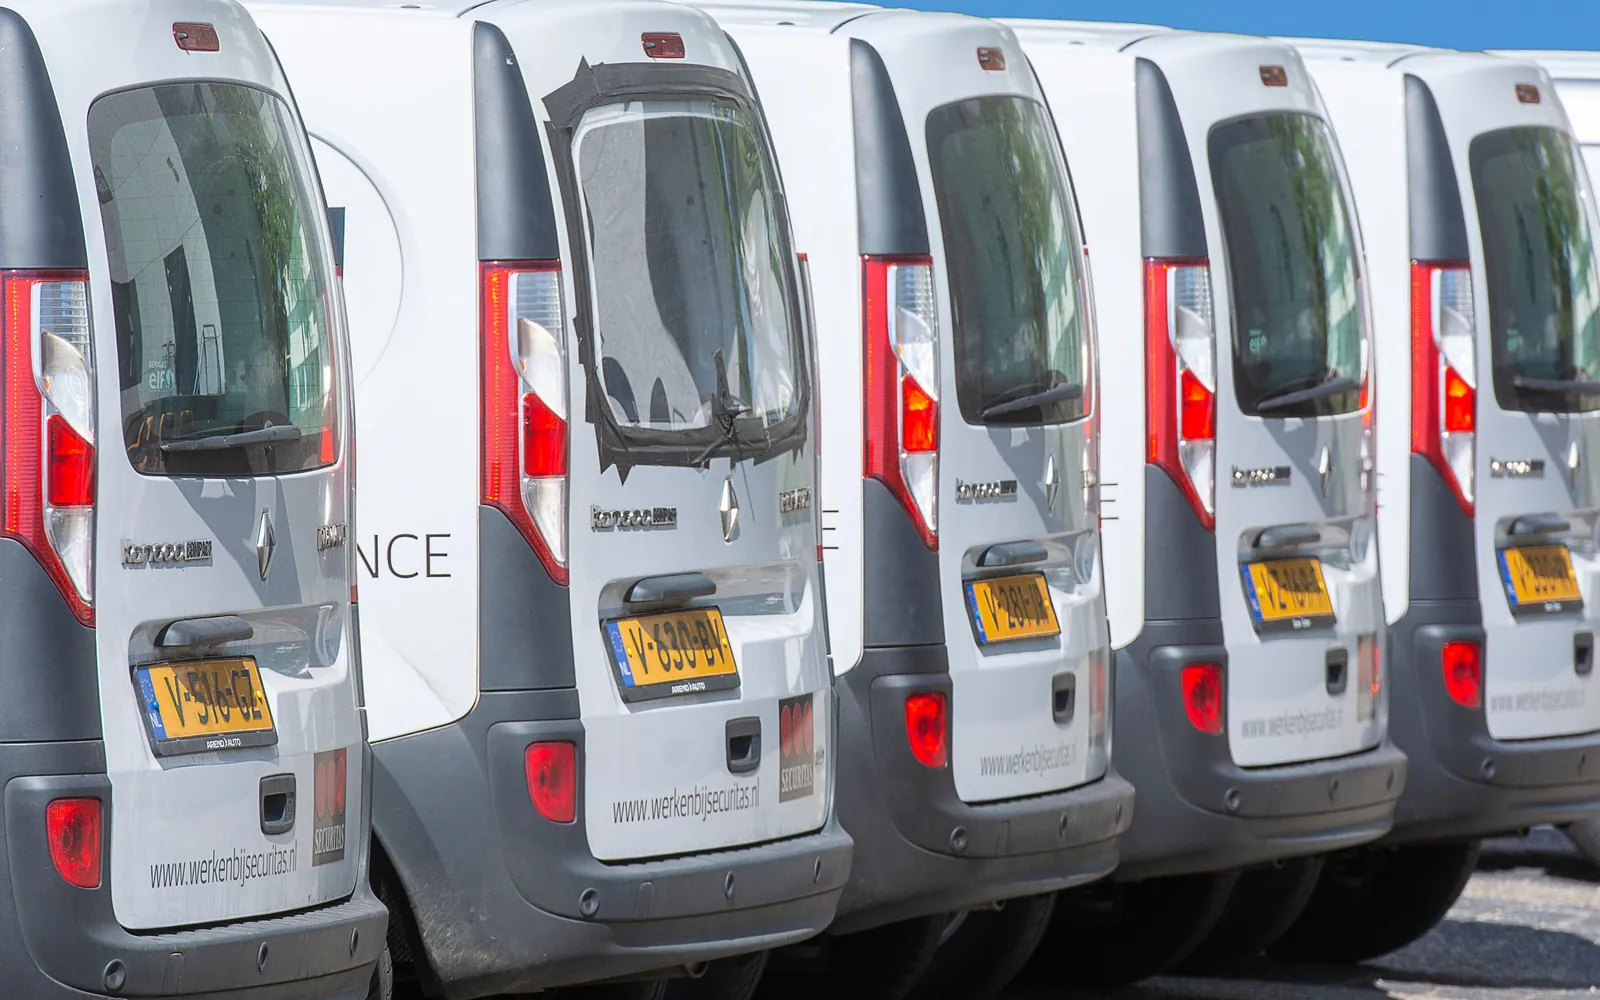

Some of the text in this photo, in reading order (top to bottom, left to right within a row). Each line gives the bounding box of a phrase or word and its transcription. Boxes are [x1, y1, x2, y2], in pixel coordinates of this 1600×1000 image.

[149, 370, 166, 389] elf
[120, 538, 185, 563] Kangoo
[356, 533, 452, 579] NCE
[628, 618, 726, 675] V-630-BV
[619, 661, 631, 676] NL
[164, 668, 262, 728] V-516-GZ
[149, 712, 162, 728] NL
[780, 763, 813, 793] SECURITAS
[612, 776, 760, 824] www.werkenbijsecuritas.nl
[314, 824, 345, 855] SECURITAS
[150, 839, 298, 888] www.werkenbijsecuritas.nl
